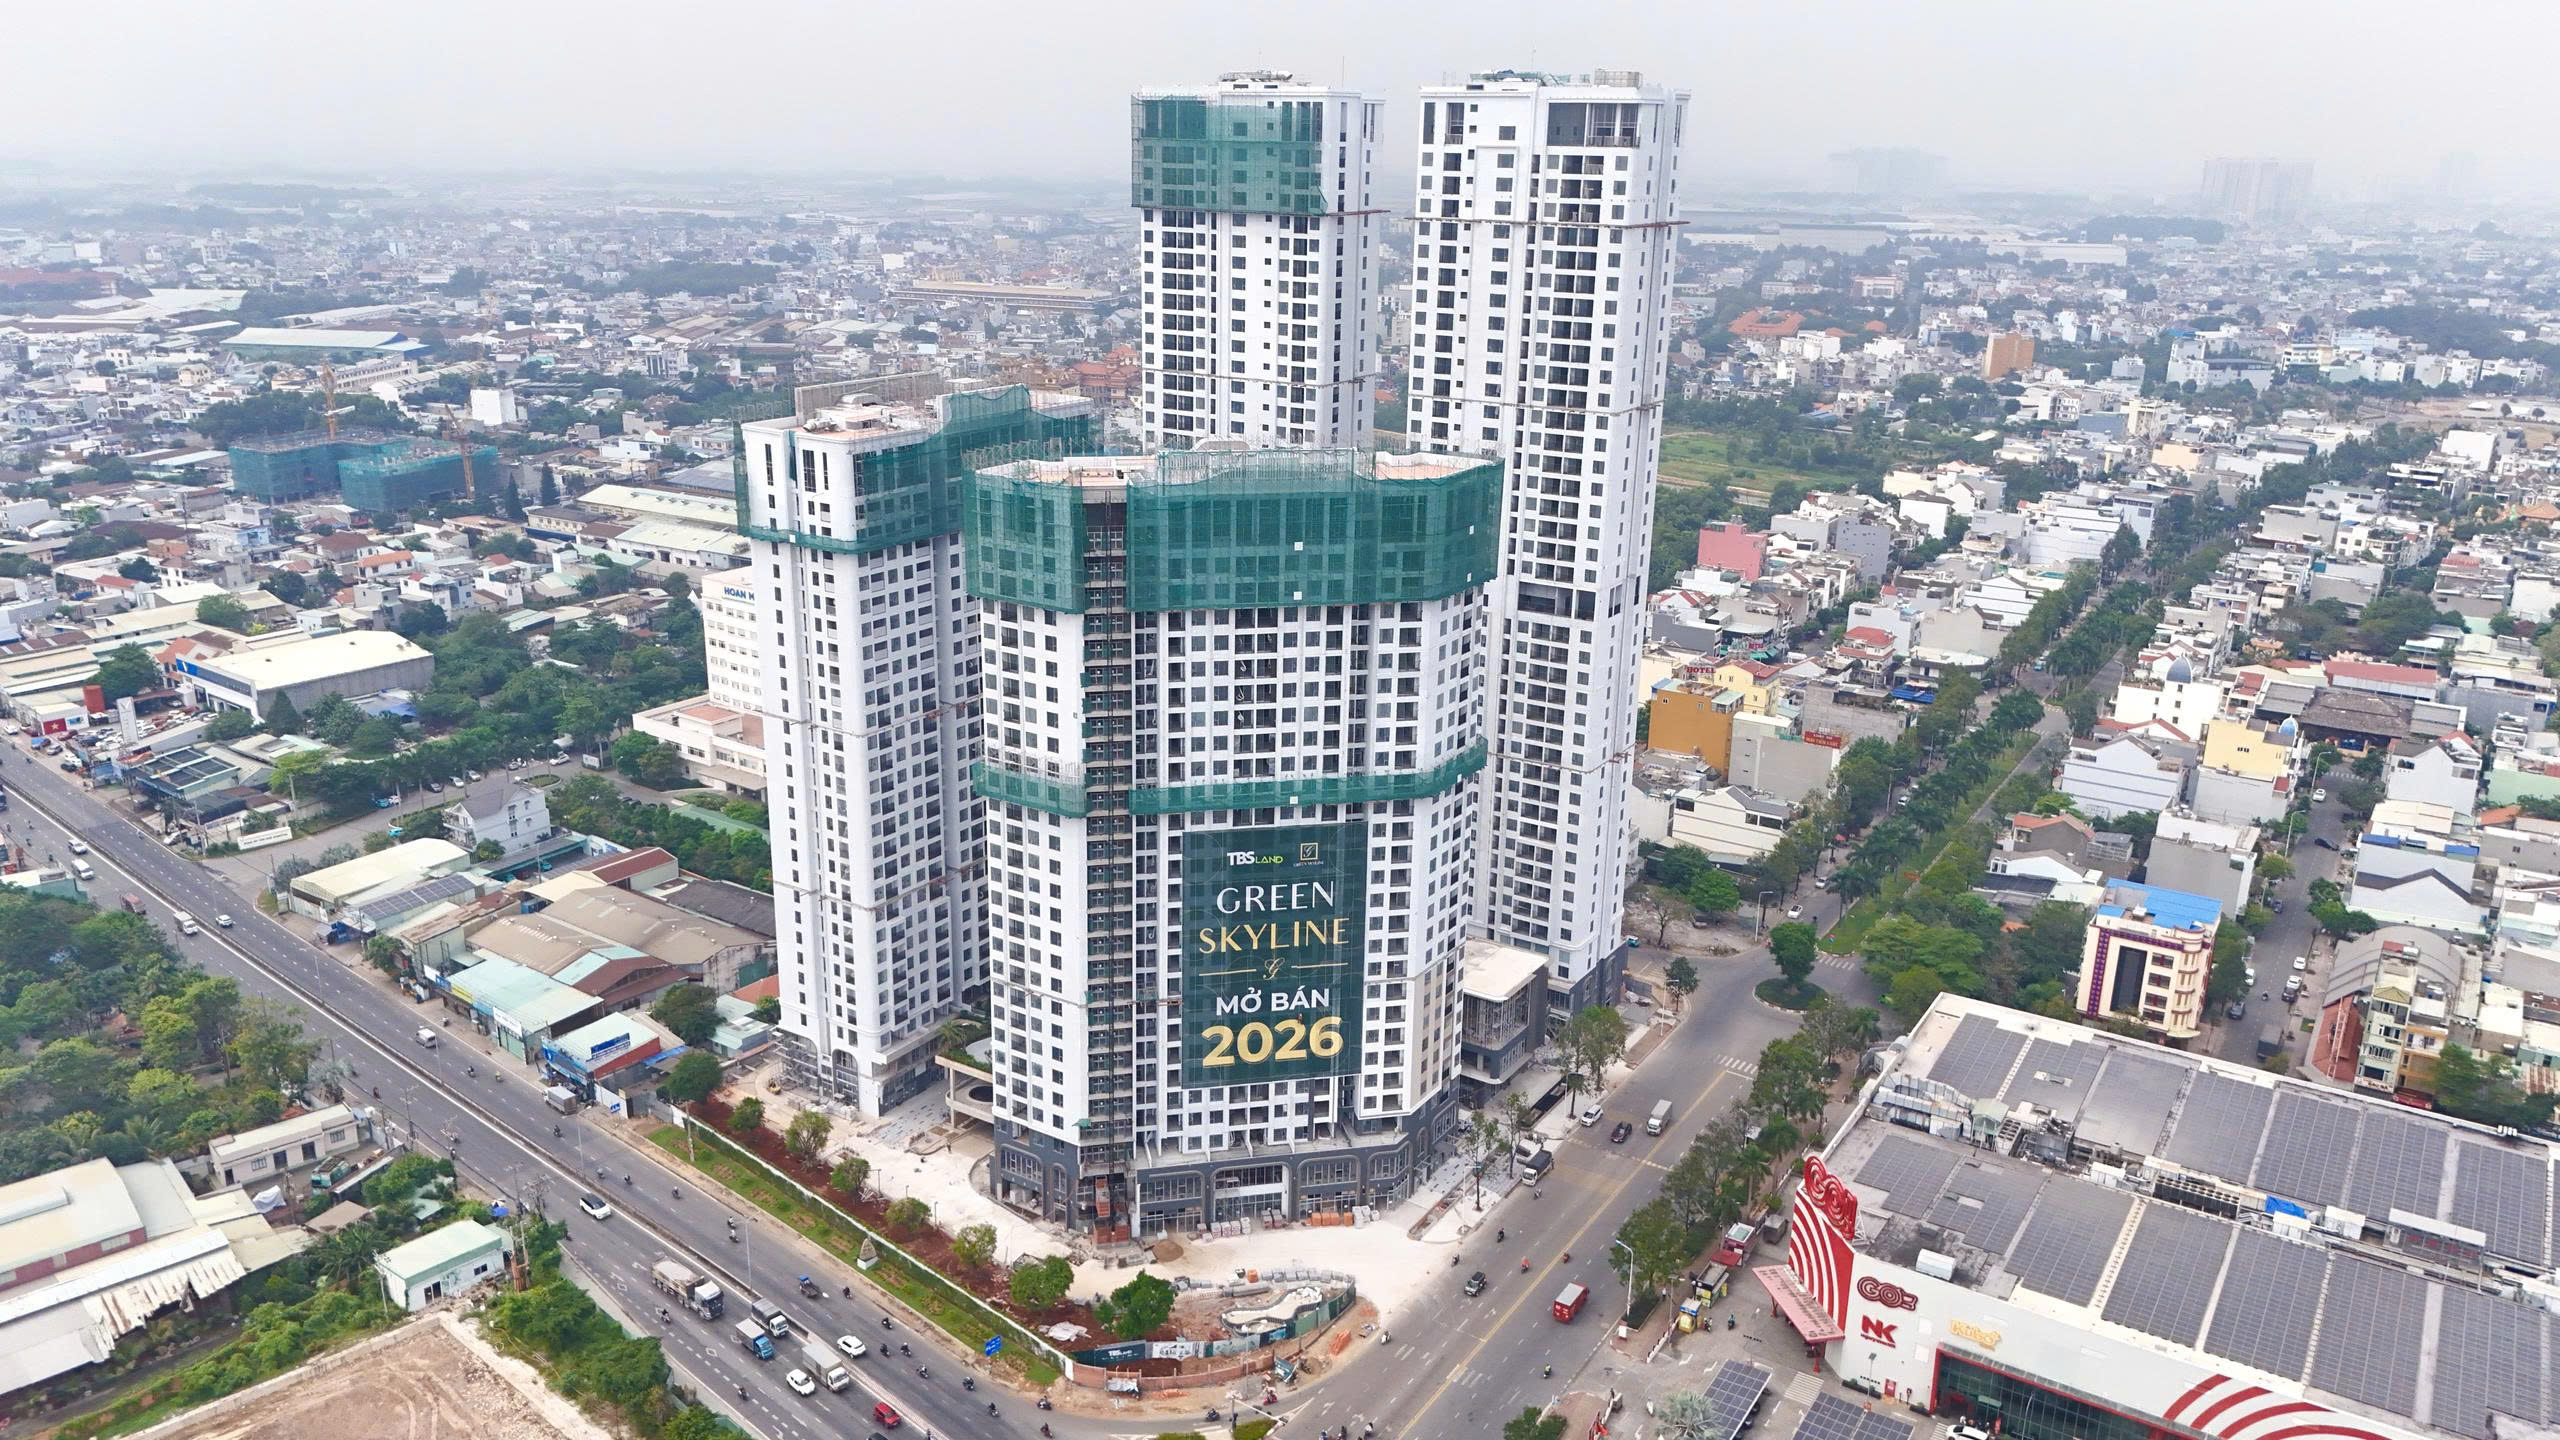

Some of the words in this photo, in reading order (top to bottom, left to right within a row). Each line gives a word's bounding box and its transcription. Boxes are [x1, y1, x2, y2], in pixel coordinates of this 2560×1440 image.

[1686, 666, 1717, 674] HOTEL
[1227, 851, 1255, 866] TBS
[1256, 855, 1284, 864] LAND
[1216, 880, 1335, 914] GREEN
[1199, 917, 1350, 954] SKYLINE
[1216, 987, 1262, 1016] MỞ
[1271, 985, 1330, 1012] BÁN
[1201, 1016, 1344, 1067] 2026
[1862, 1314, 1897, 1343] NK
